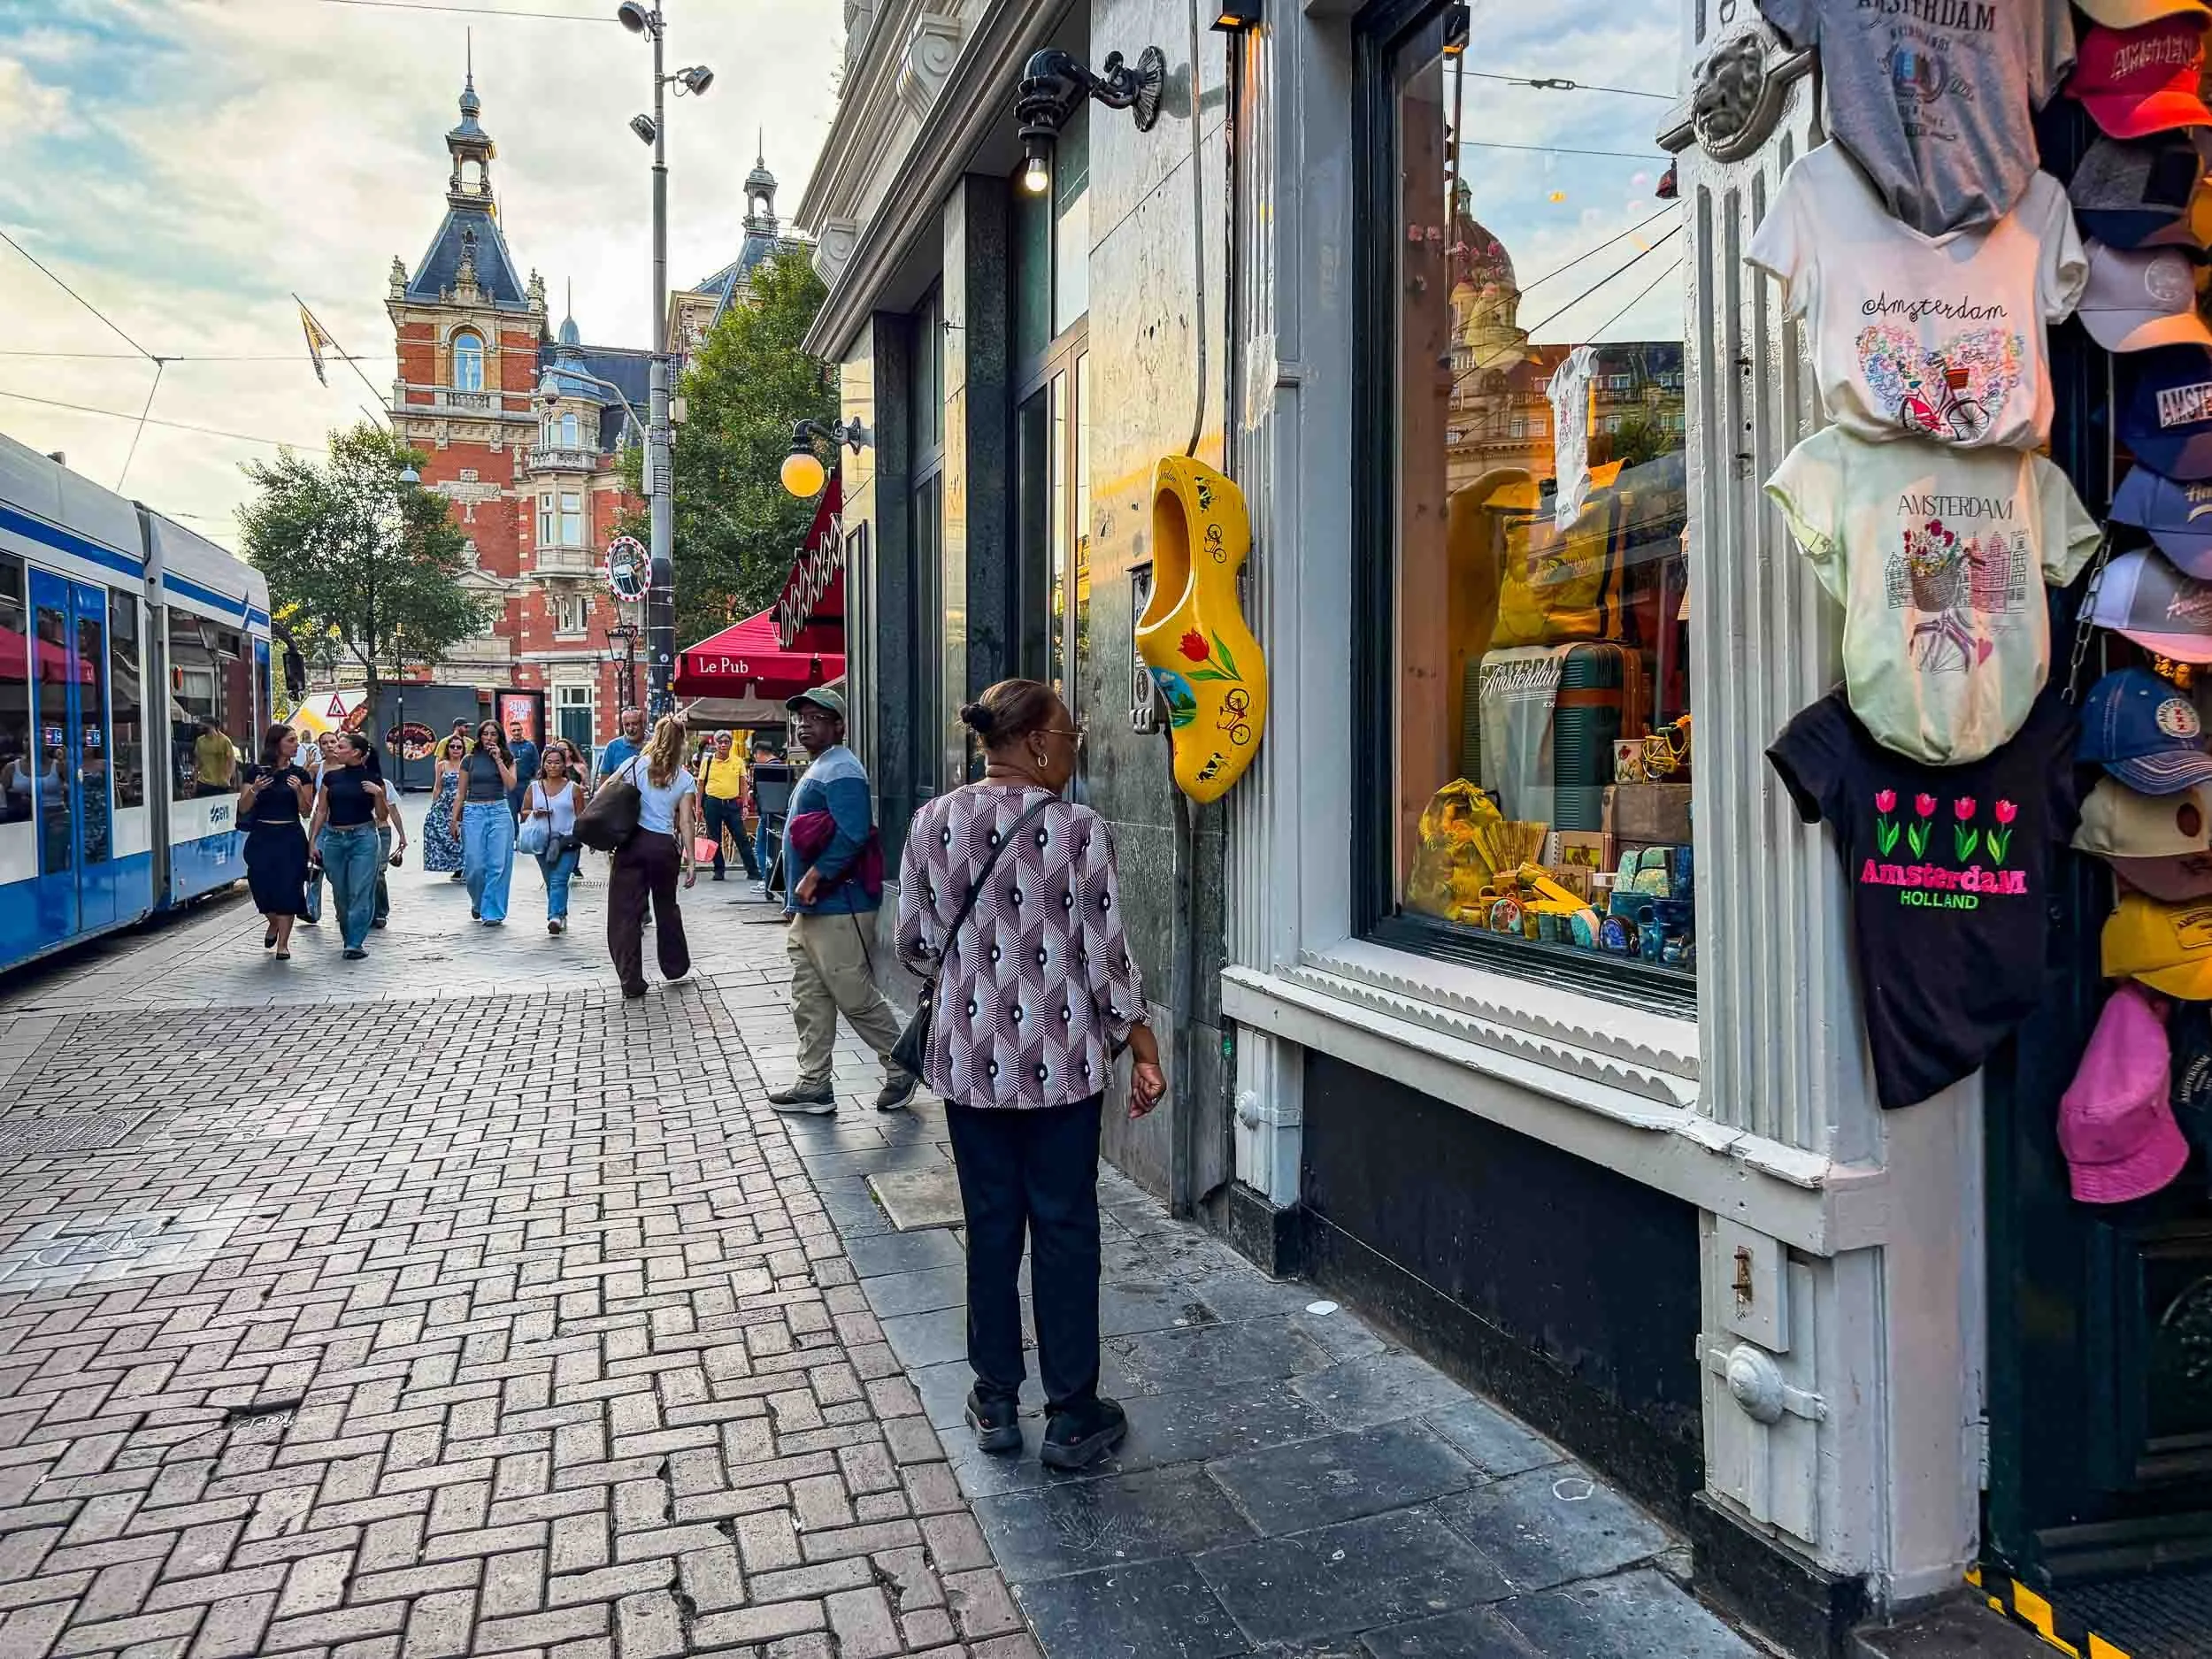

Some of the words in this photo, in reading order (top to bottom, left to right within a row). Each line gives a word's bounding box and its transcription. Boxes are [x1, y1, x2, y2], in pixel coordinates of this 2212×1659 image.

[1857, 0, 1996, 31] MSTERDAM
[1897, 495, 2013, 519] AMSTERDAM
[698, 657, 717, 673] Le
[721, 657, 749, 673] Pub
[1901, 890, 1978, 910] HOLLAND
